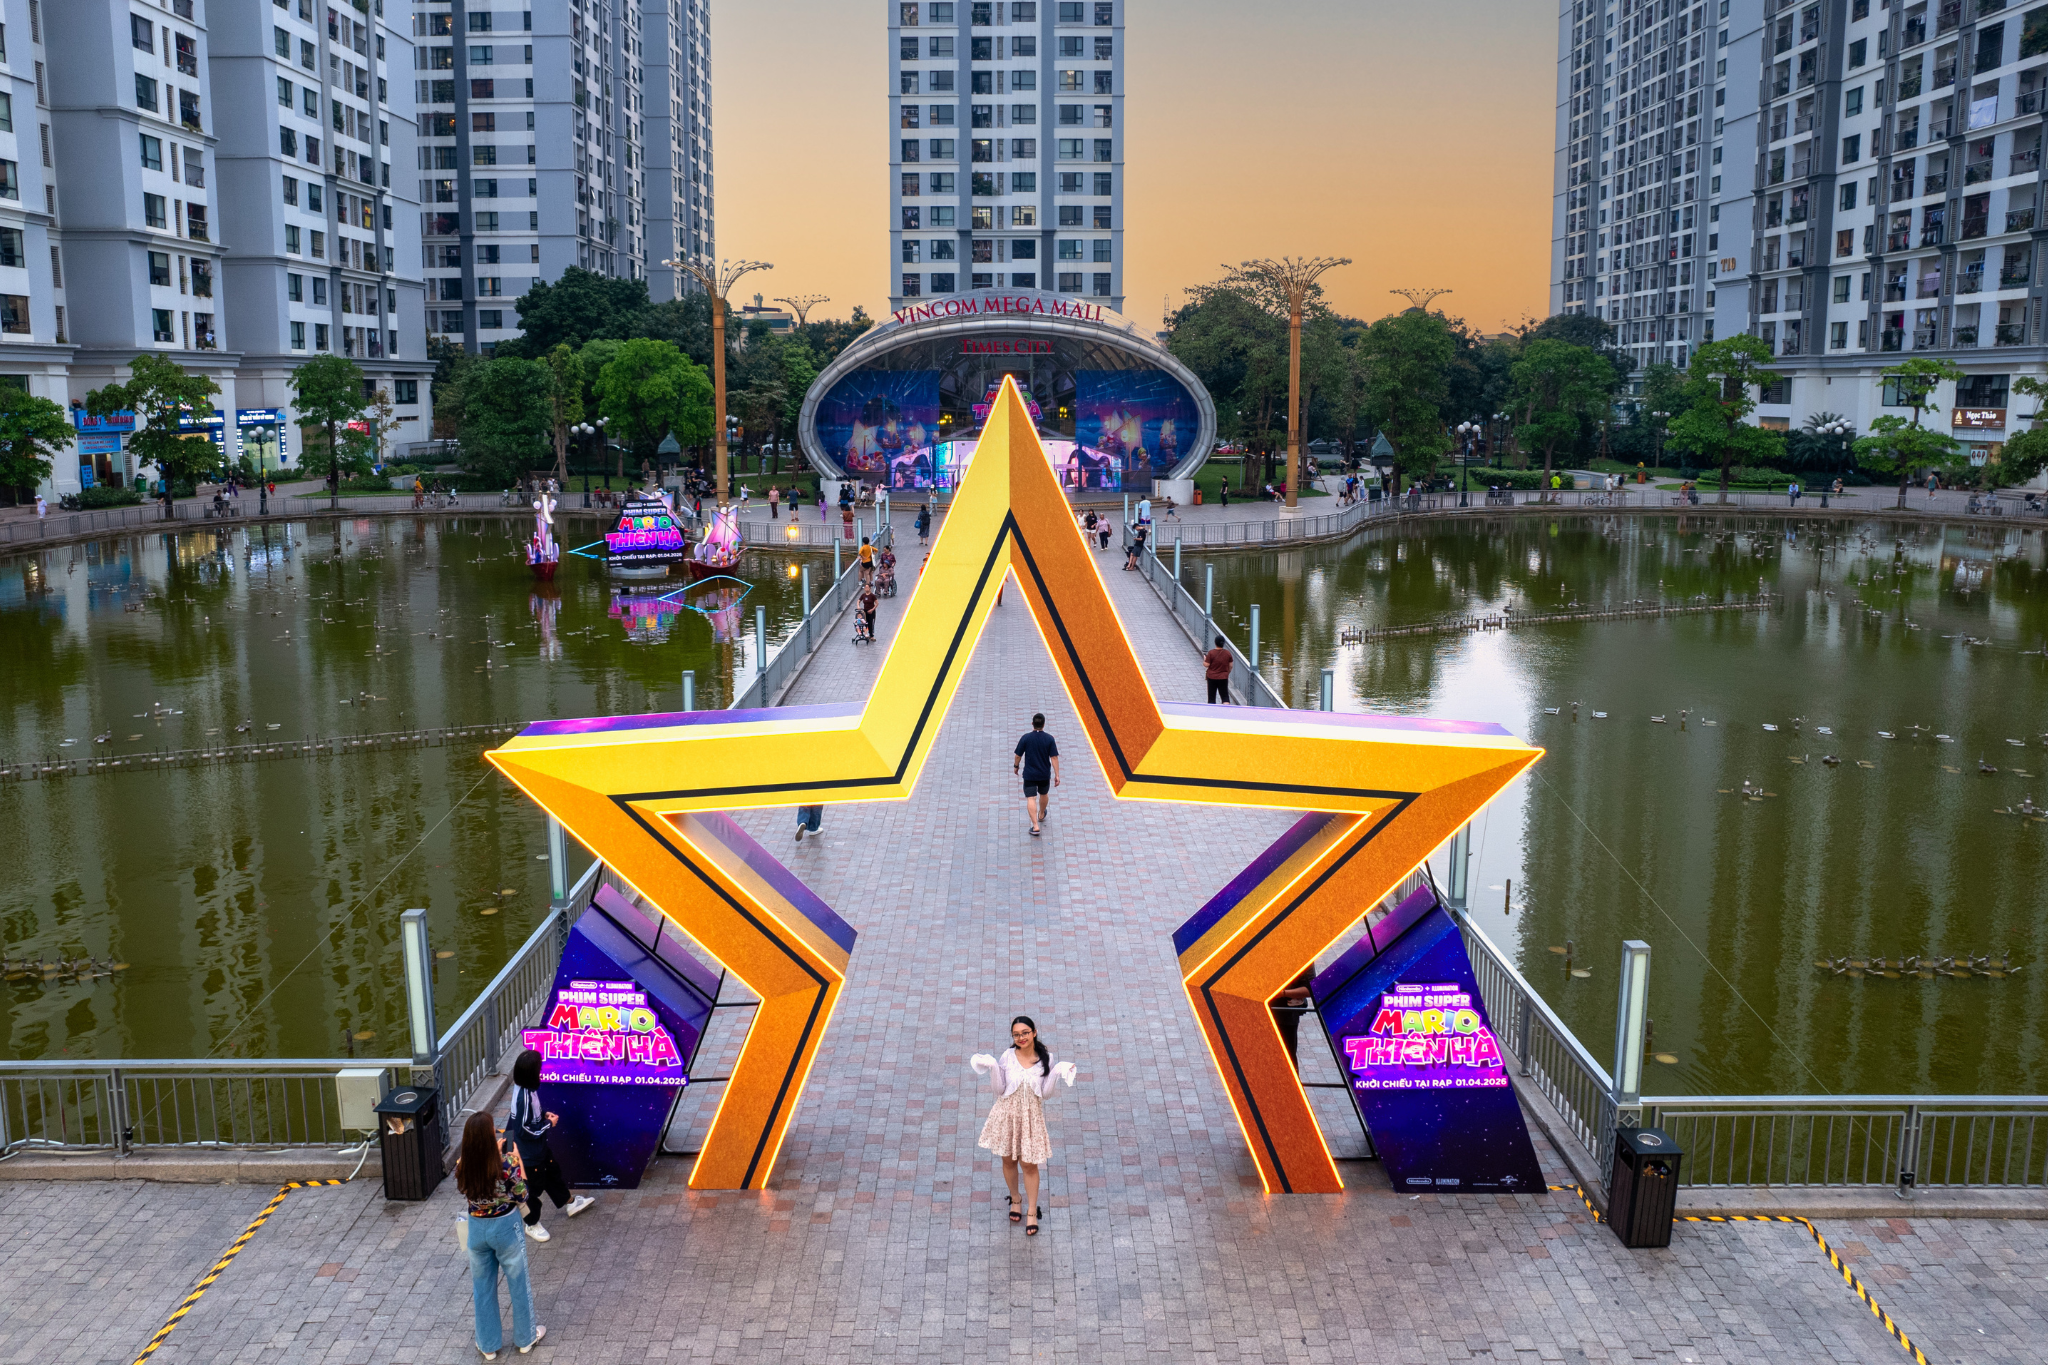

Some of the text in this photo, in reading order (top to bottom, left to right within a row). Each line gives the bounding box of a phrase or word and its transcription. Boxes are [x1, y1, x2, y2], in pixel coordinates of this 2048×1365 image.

[1720, 257, 1736, 272] T10
[893, 296, 1105, 325] VINCOM MEGA MALL
[961, 338, 1055, 354] TIMES CITY
[618, 516, 672, 531] MARIO
[605, 525, 685, 551] THIÊN HÀ
[559, 991, 645, 1005] PHIM SUPER
[1384, 994, 1470, 1008] PHIM SUPER
[548, 1004, 656, 1034] MARIO
[1371, 1008, 1480, 1035] MARIO
[524, 1026, 682, 1067] THIÊN HÀ
[1345, 1026, 1503, 1070] THIÊN HÀ
[563, 1071, 592, 1082] CHIẾU
[594, 1075, 609, 1085] TẠI
[612, 1076, 632, 1085] RẠP
[634, 1077, 686, 1085] 01.04.2026
[1356, 1077, 1507, 1089] KHỞI CHIẾU TẠI RẠP 01.04.2026
